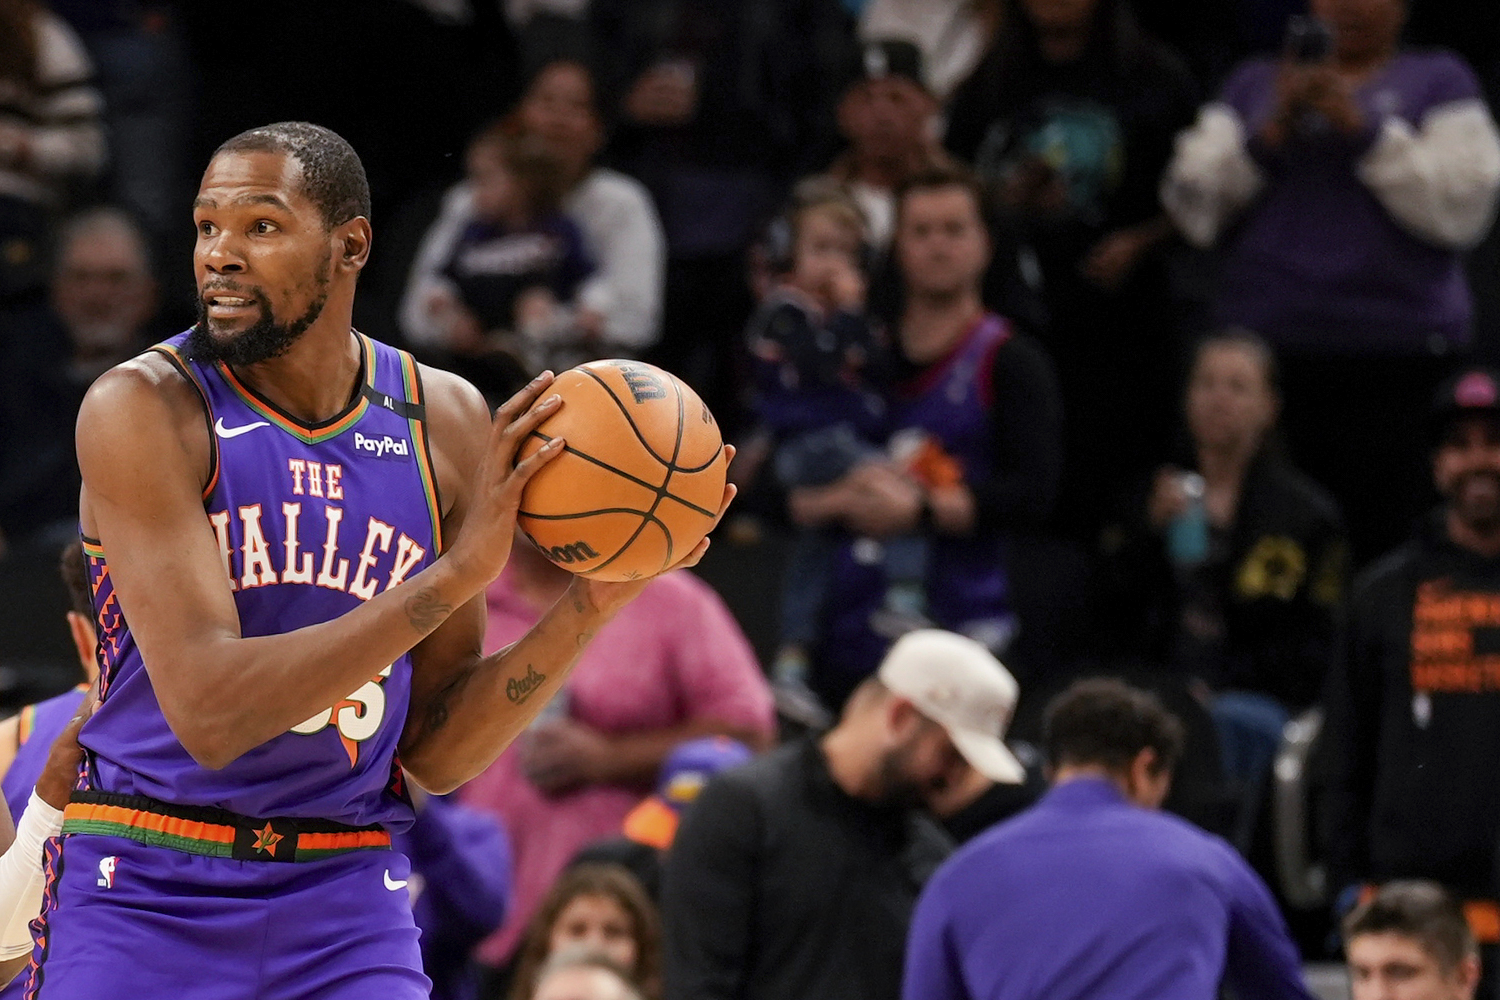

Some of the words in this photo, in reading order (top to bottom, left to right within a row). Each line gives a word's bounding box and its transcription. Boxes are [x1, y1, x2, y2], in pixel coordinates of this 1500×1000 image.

[384, 396, 394, 410] AL
[354, 432, 408, 457] PayPal
[288, 458, 343, 500] THE
[287, 664, 393, 742] 5
